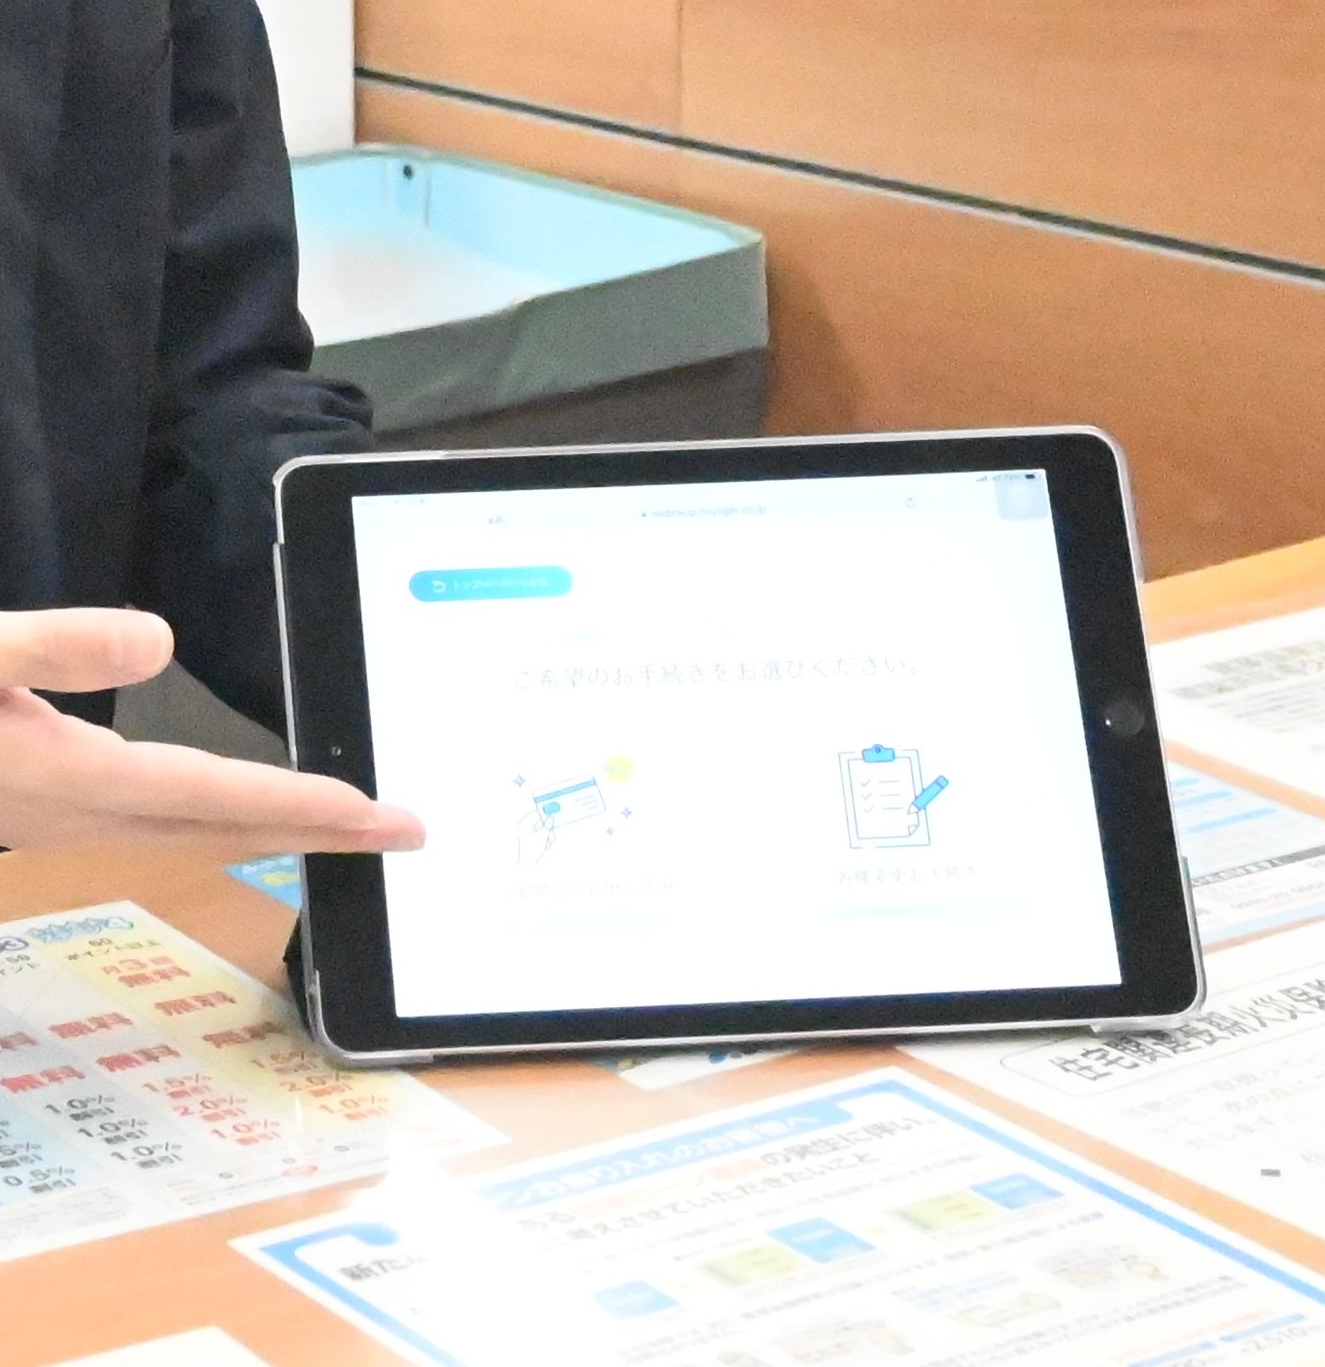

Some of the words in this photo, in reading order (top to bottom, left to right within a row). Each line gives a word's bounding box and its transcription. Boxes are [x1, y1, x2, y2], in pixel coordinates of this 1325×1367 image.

[514, 655, 919, 690] ご希望のお手続きをお選びください。
